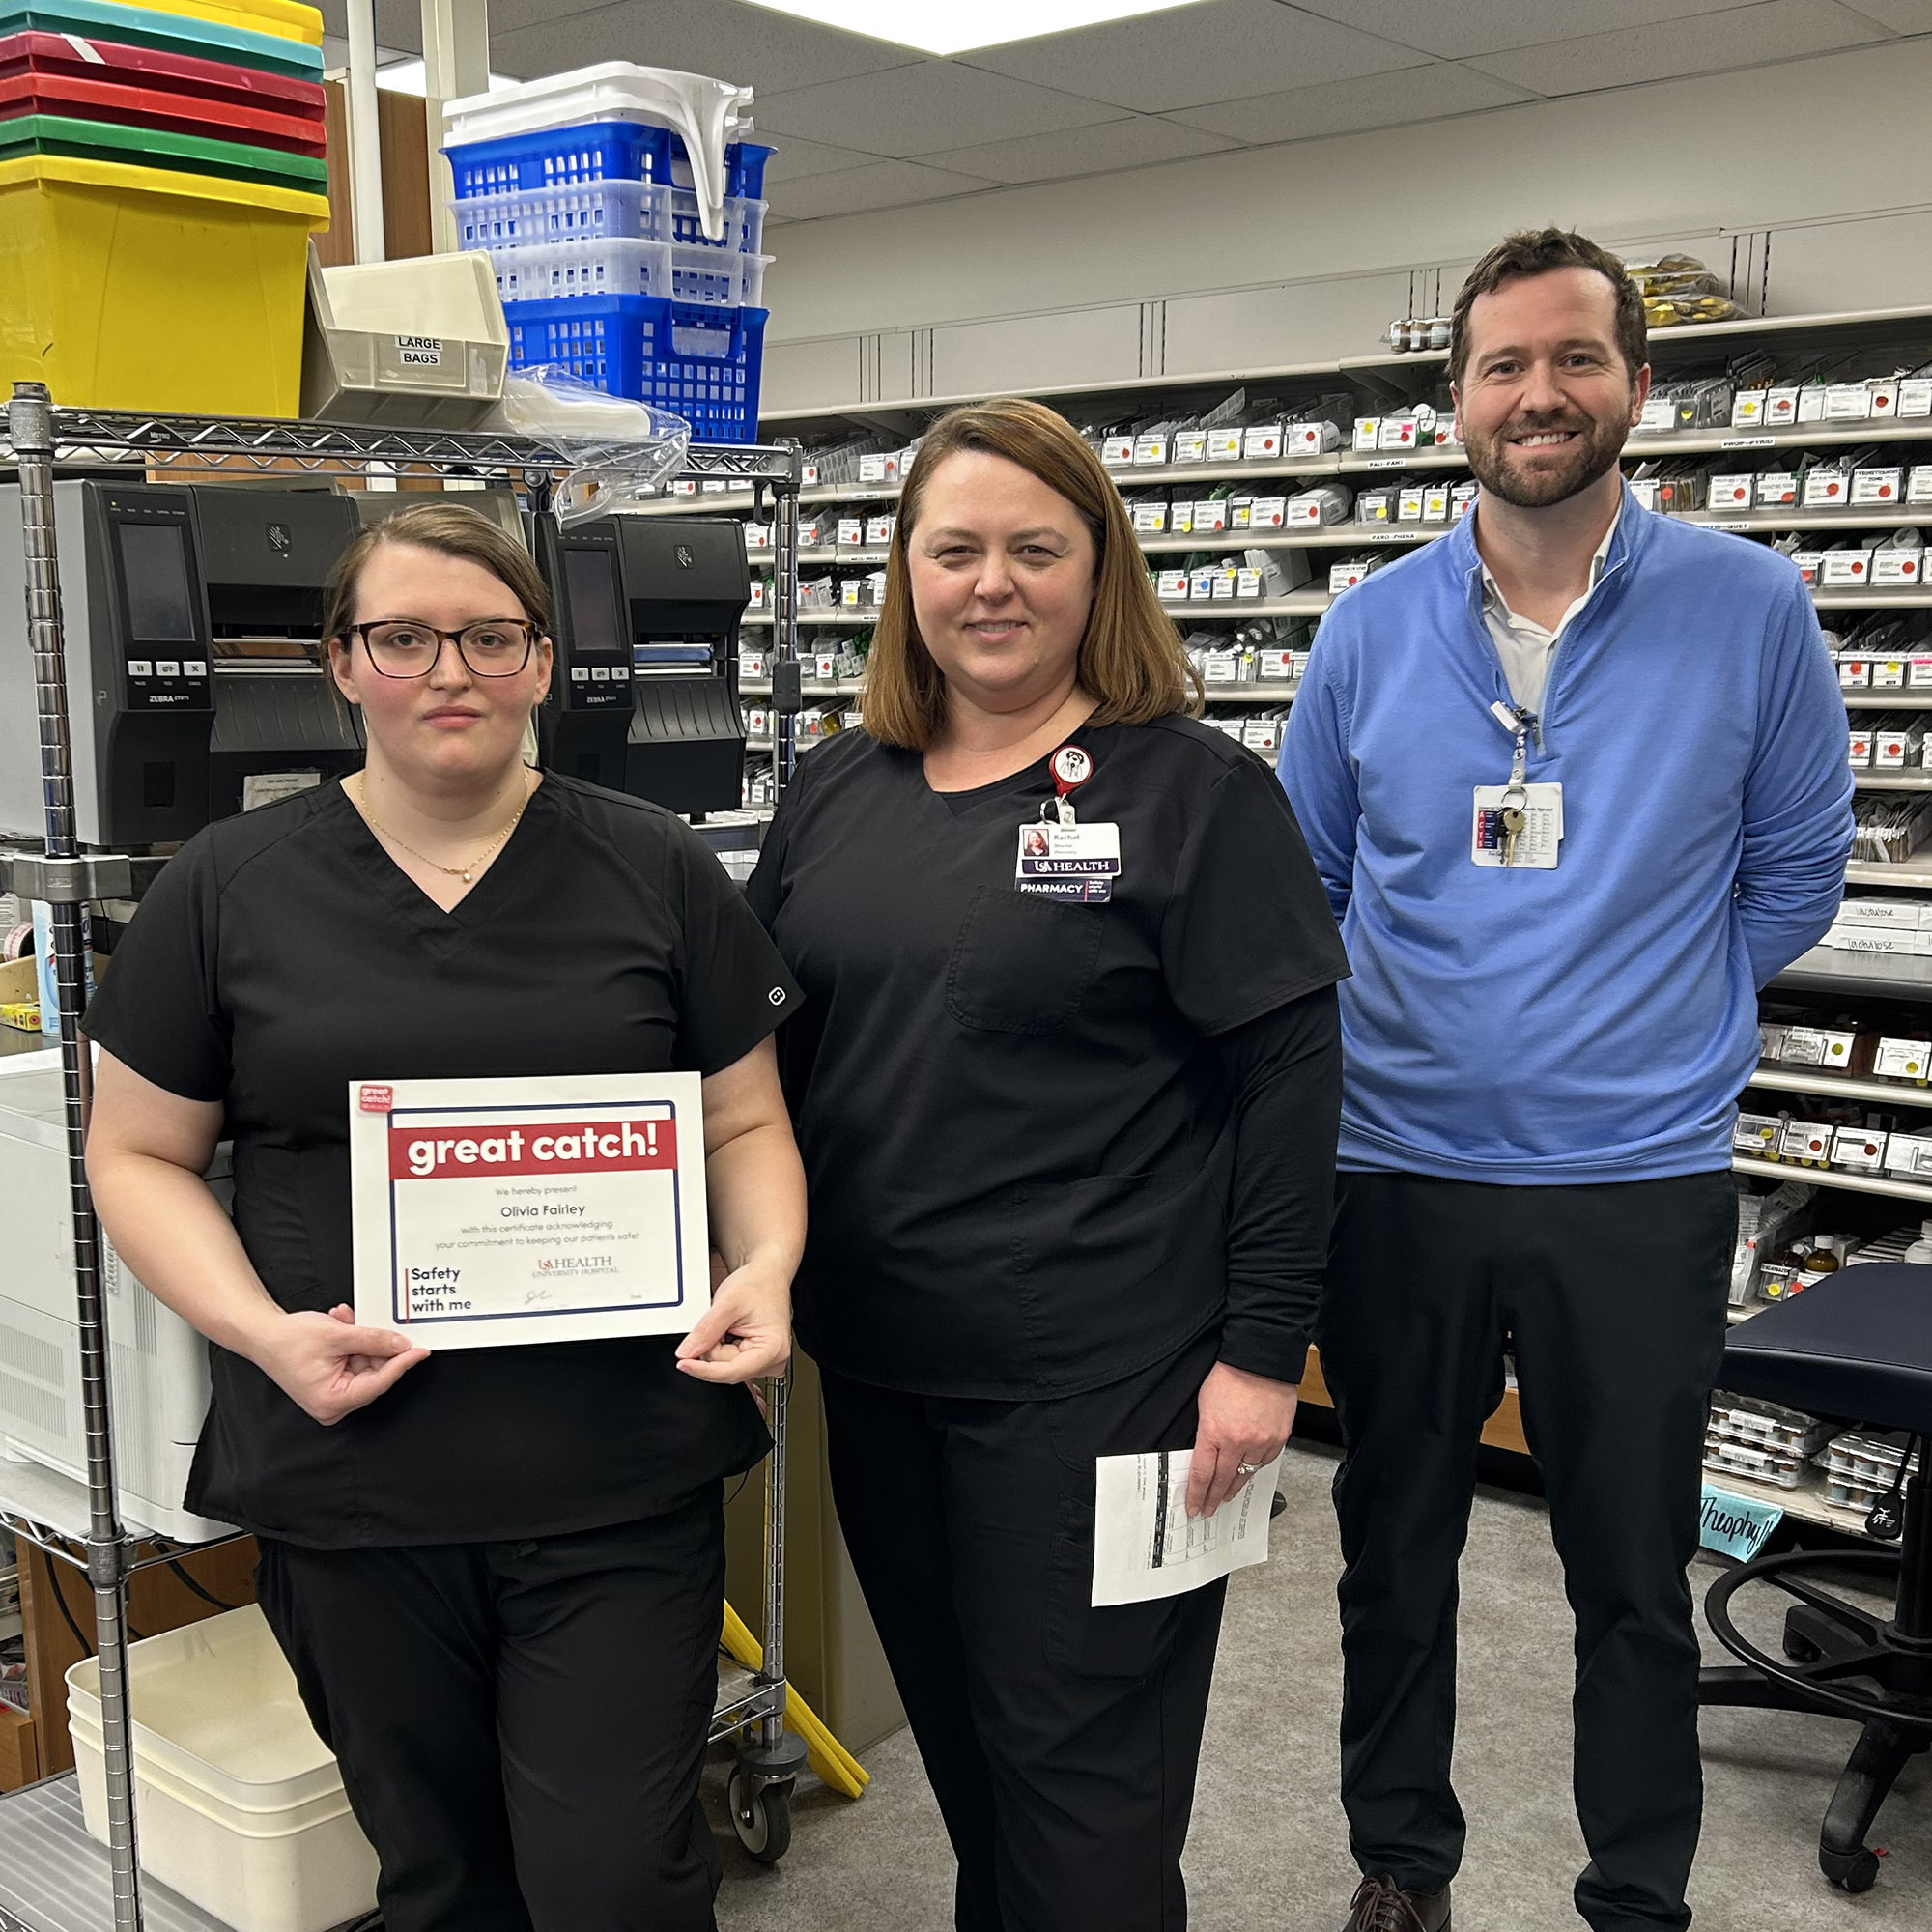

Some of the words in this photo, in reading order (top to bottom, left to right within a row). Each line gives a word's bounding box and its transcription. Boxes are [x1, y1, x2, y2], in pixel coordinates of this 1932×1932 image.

[398, 335, 440, 350] LARGE
[403, 353, 438, 364] BAGS
[1054, 861, 1110, 871] HEALTH
[1020, 883, 1084, 894] PHARMACY
[408, 1129, 525, 1177] great
[531, 1122, 659, 1160] catch!
[511, 1187, 542, 1196] hereby
[544, 1185, 578, 1195] present
[501, 1206, 539, 1217] Olivia
[543, 1204, 586, 1217] Fairley
[461, 1225, 480, 1234] with
[482, 1224, 497, 1233] this
[499, 1222, 543, 1232] certificate
[546, 1220, 612, 1231] acknowledging
[435, 1242, 455, 1252] your
[457, 1238, 513, 1248] commitment
[526, 1236, 561, 1246] keeping
[581, 1234, 615, 1243] patients
[554, 1256, 612, 1269] HEALTH
[412, 1267, 461, 1283] Safety
[532, 1268, 580, 1278] UNIVERSITY
[581, 1266, 619, 1275] HOSPITAL
[412, 1284, 456, 1296] starts
[412, 1298, 444, 1312] with
[448, 1300, 472, 1311] me
